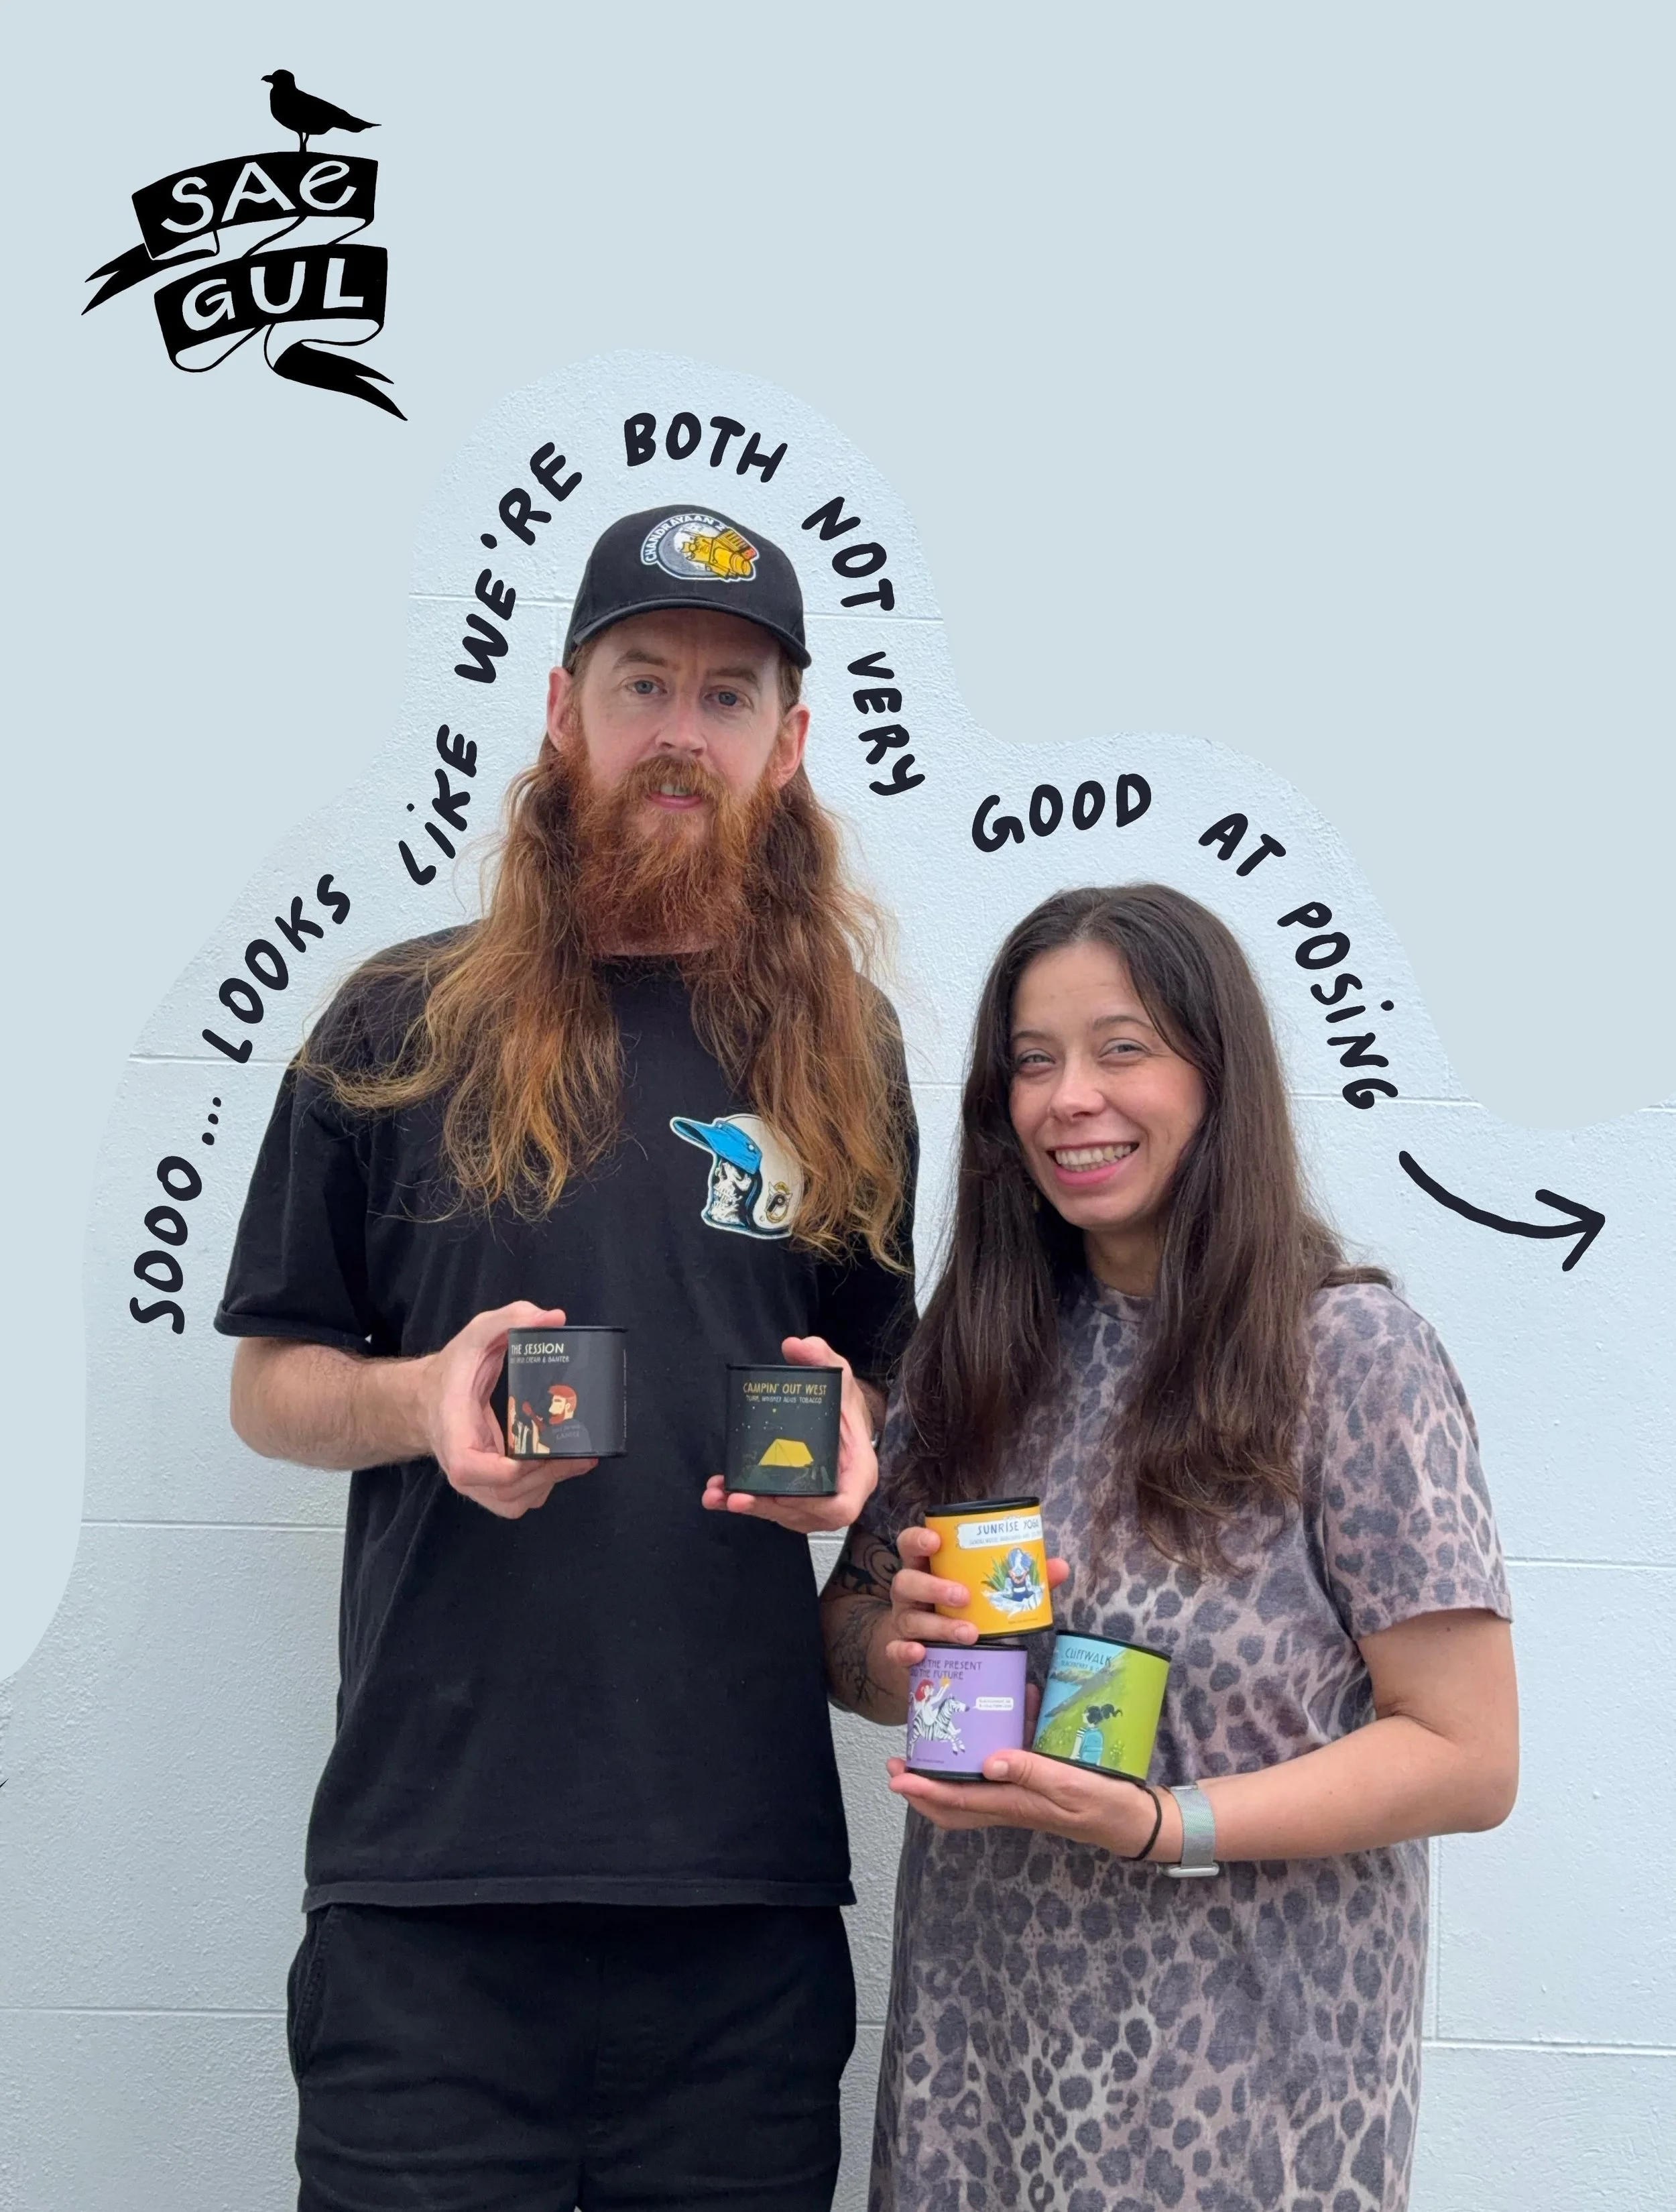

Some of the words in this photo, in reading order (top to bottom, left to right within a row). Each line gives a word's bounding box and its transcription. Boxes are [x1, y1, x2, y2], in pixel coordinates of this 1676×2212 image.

[644, 515, 715, 562] CHANDRAYAAN
[511, 1344, 522, 1355] THE
[782, 1383, 802, 1395] OUT
[805, 1384, 827, 1395] WEST
[927, 1659, 941, 1669] THE
[944, 1660, 983, 1671] PRESENT
[933, 1670, 964, 1680] FUTURE
